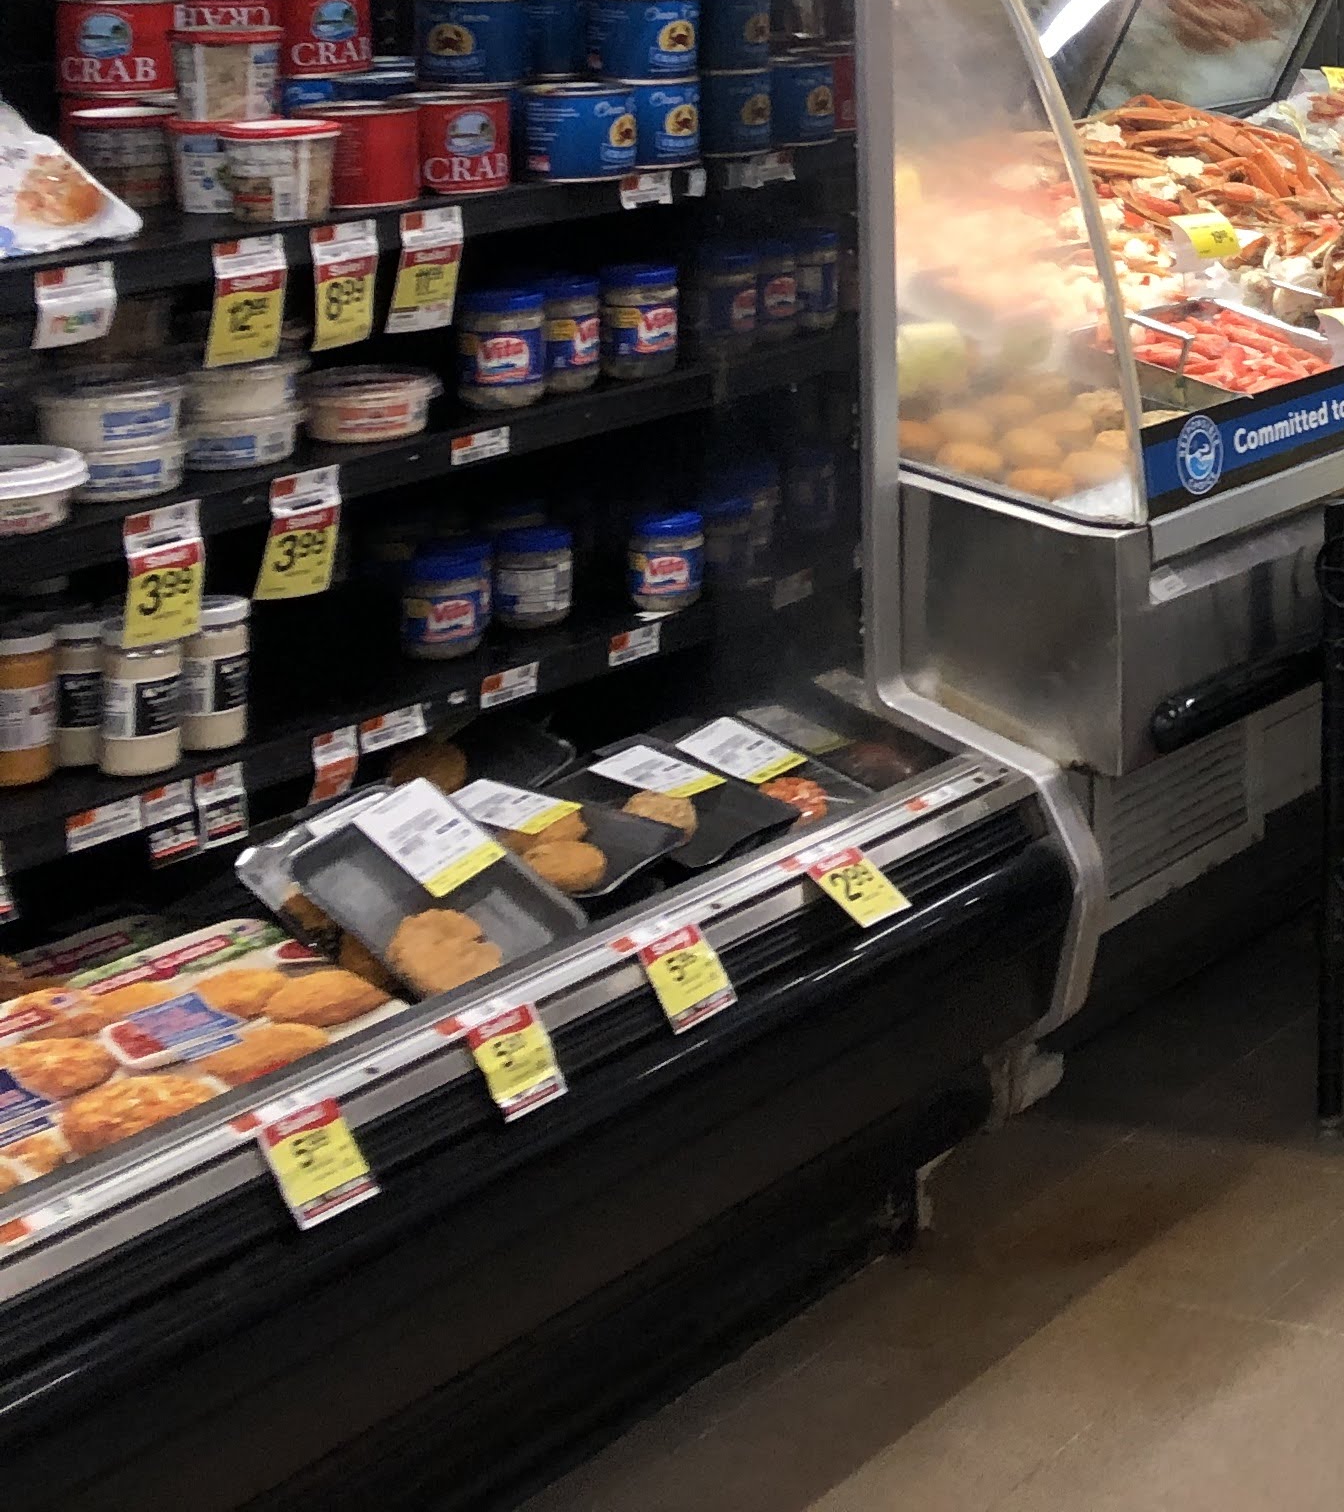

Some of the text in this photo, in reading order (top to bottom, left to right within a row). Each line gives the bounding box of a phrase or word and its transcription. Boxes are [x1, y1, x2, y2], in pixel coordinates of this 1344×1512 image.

[61, 55, 158, 84] CRAB
[423, 152, 509, 185] CRAB
[1234, 404, 1329, 454] Committed
